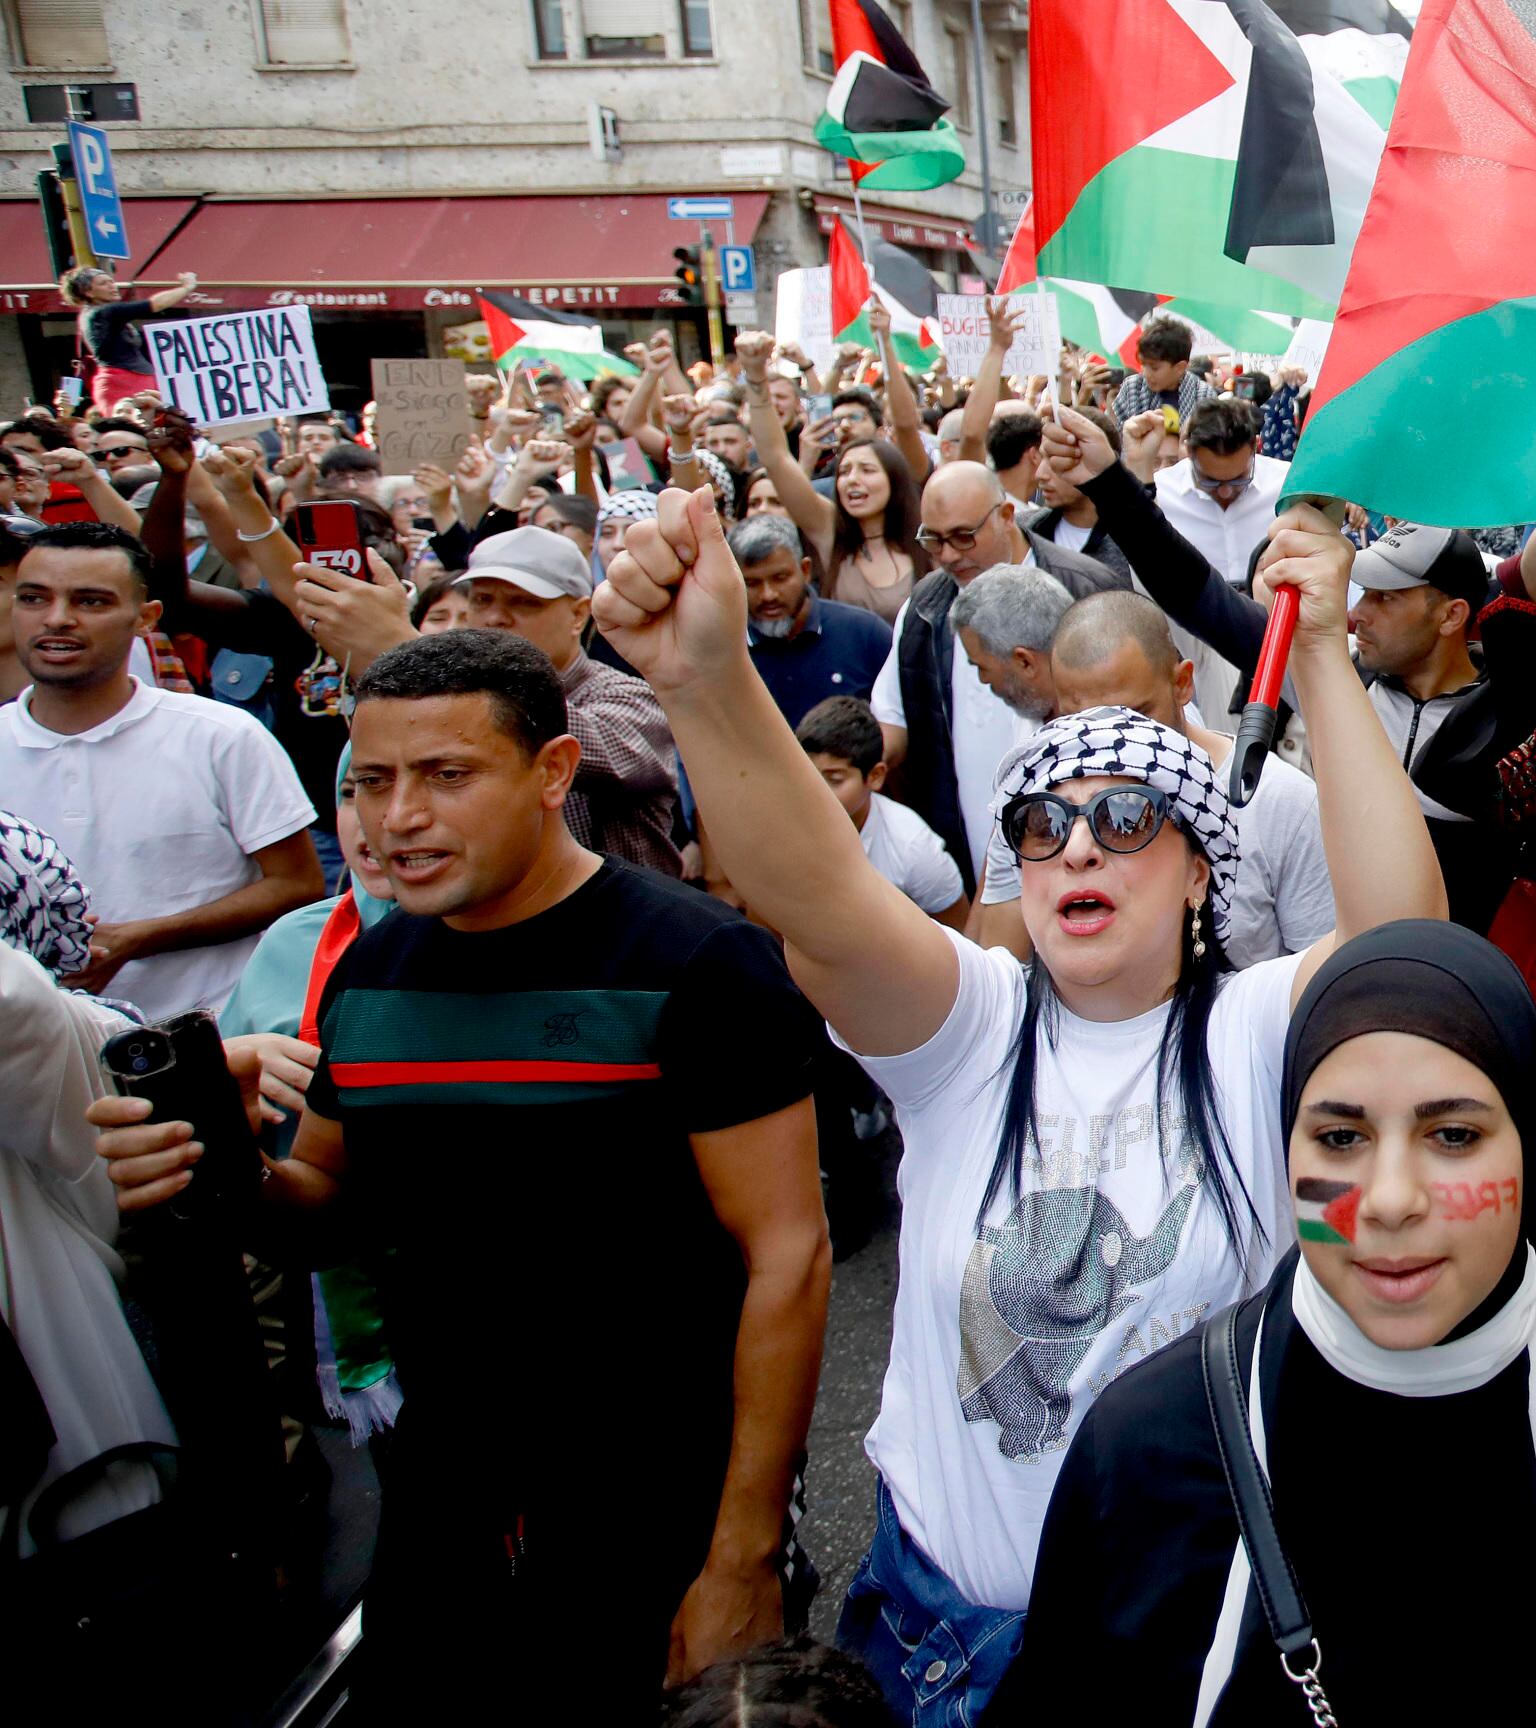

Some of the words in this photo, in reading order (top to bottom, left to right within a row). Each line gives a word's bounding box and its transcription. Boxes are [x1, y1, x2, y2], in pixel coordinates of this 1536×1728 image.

[78, 132, 105, 194] P
[267, 289, 388, 305] Restaurant
[725, 251, 747, 288] P
[153, 312, 303, 376] PALESTINA
[169, 360, 312, 424] LIBERA!
